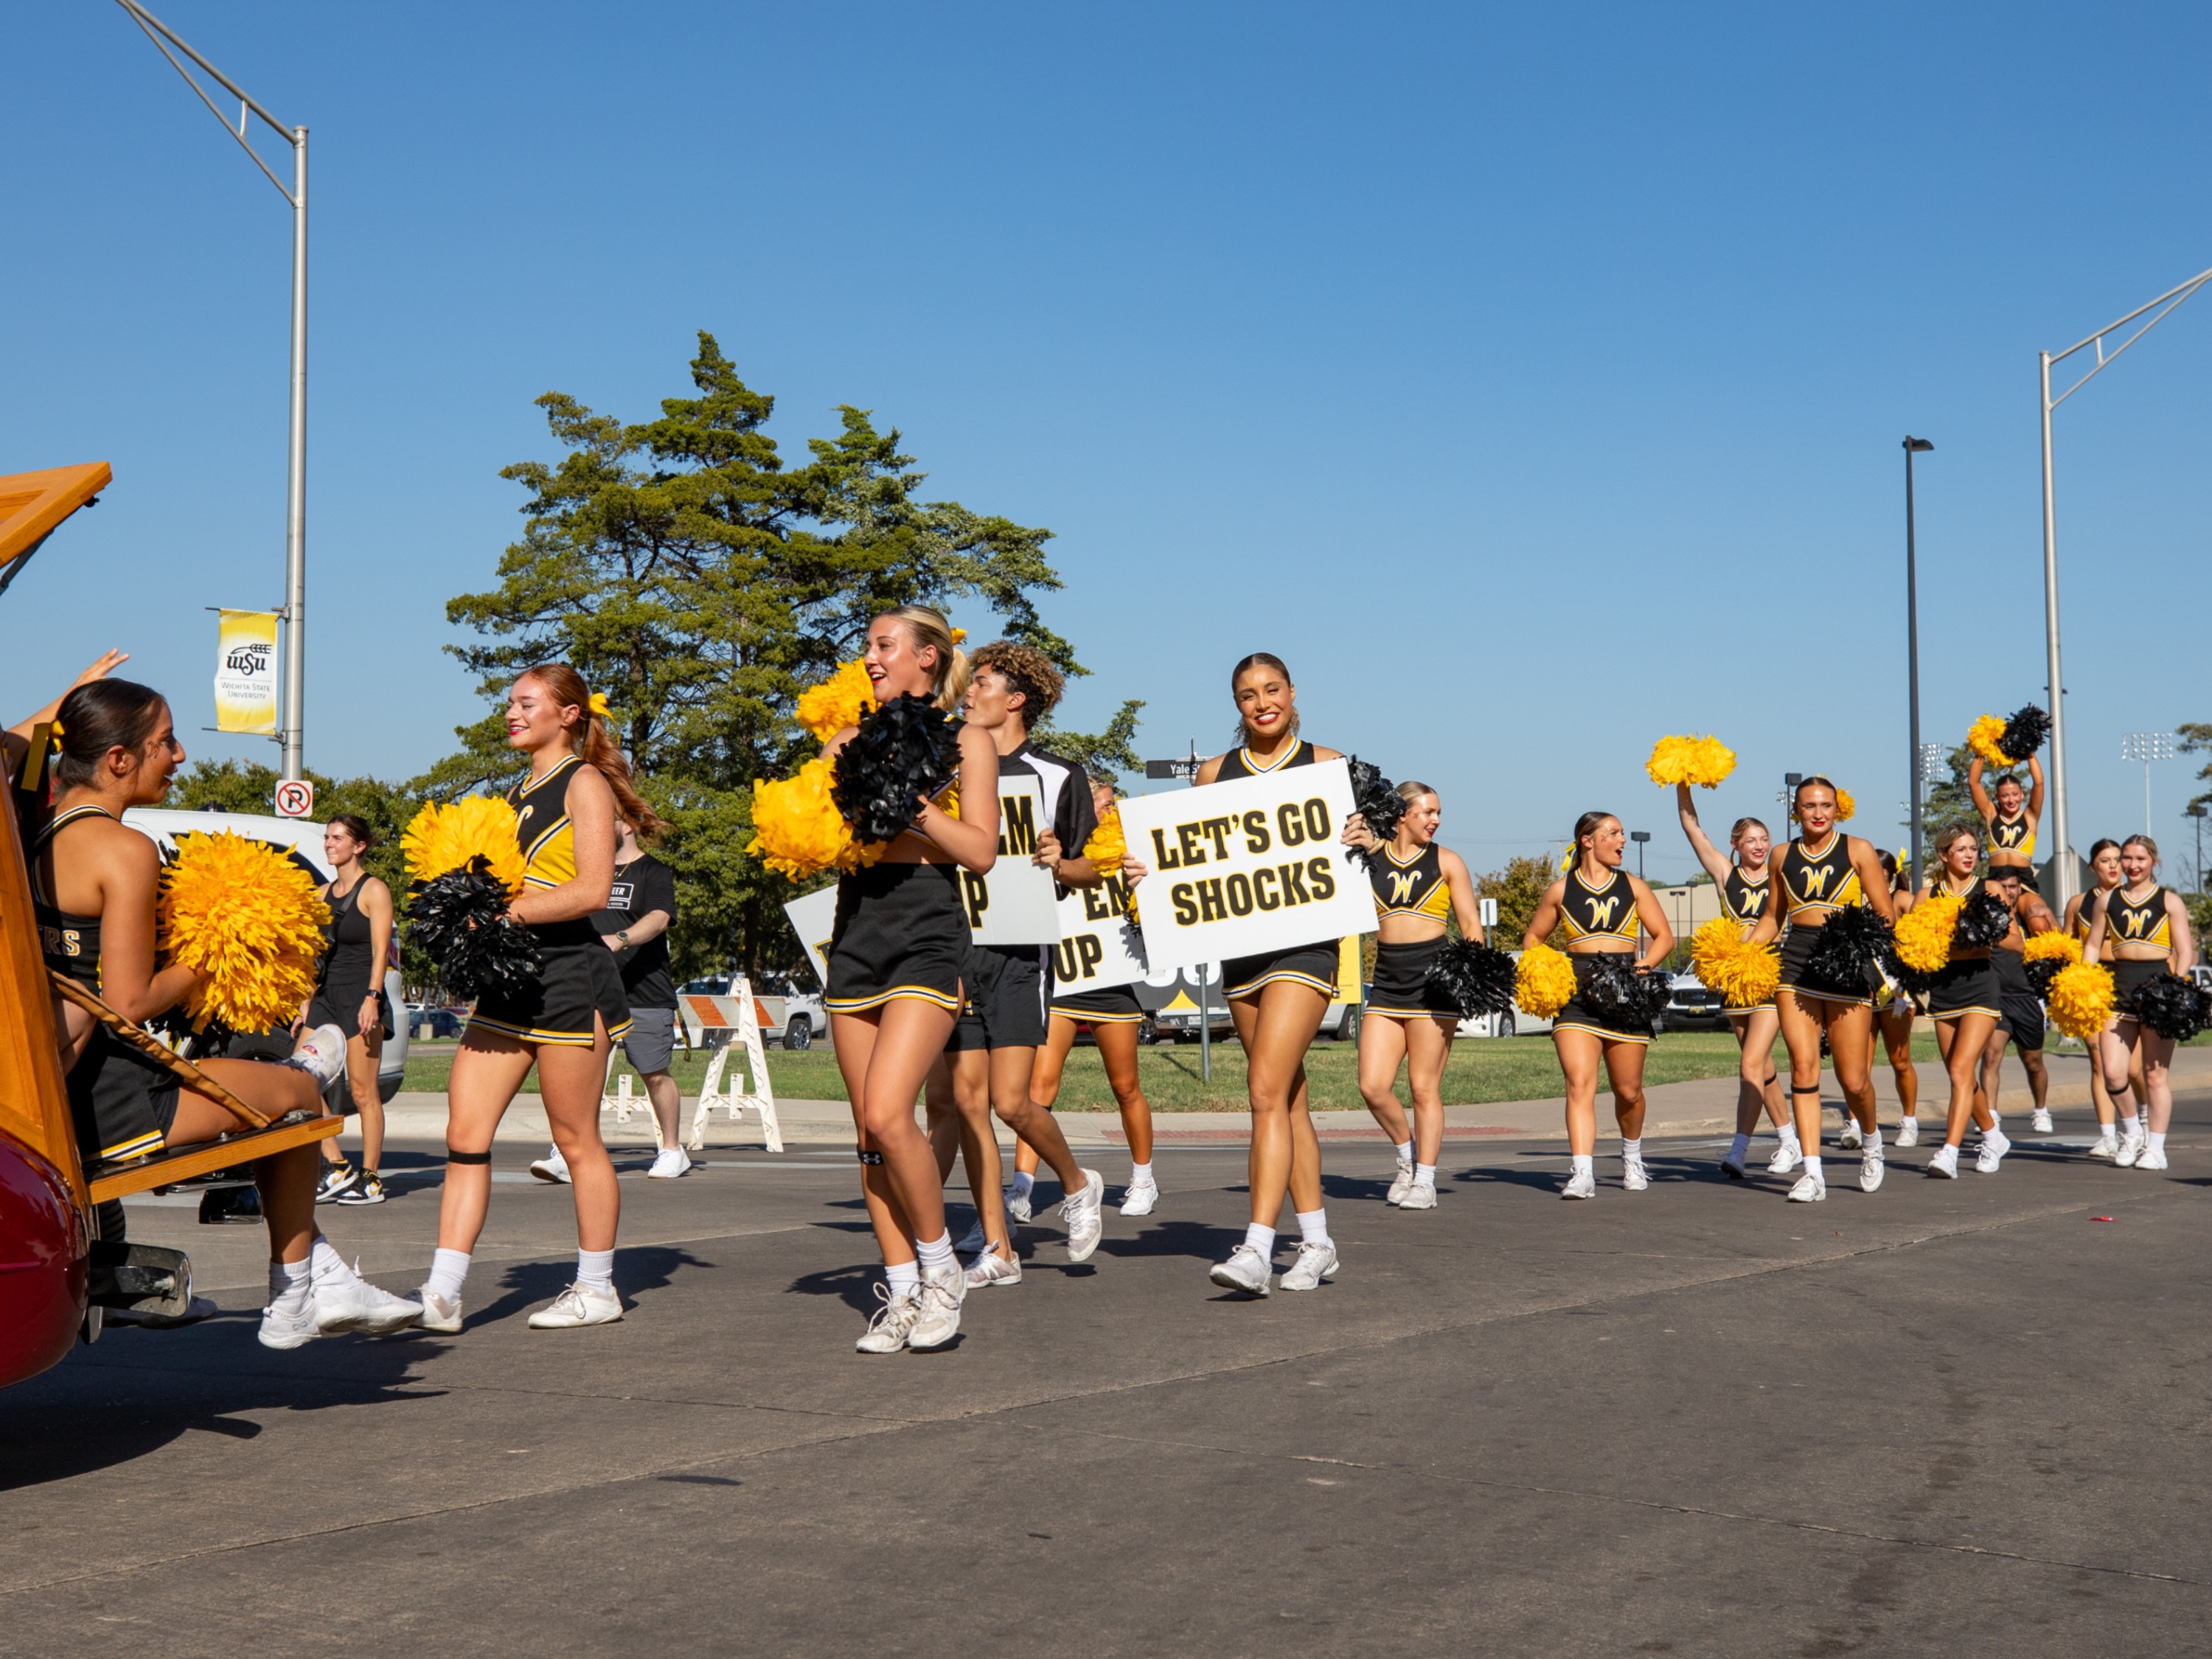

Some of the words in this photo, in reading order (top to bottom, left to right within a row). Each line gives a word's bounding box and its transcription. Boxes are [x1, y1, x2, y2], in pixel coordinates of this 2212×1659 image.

[1170, 764, 1190, 774] Yale
[1192, 763, 1200, 774] S
[288, 790, 302, 808] P
[1150, 810, 1271, 872] LET'S
[1277, 797, 1331, 847] GO
[2000, 825, 2022, 846] W
[1171, 856, 1336, 928] SHOCKS
[1387, 870, 1422, 904] W
[1801, 865, 1834, 899] W
[956, 870, 990, 929] P
[1585, 896, 1620, 929] W
[1740, 888, 1769, 915] W
[2121, 908, 2152, 938] W
[38, 924, 80, 956] RS
[1054, 933, 1102, 983] UP
